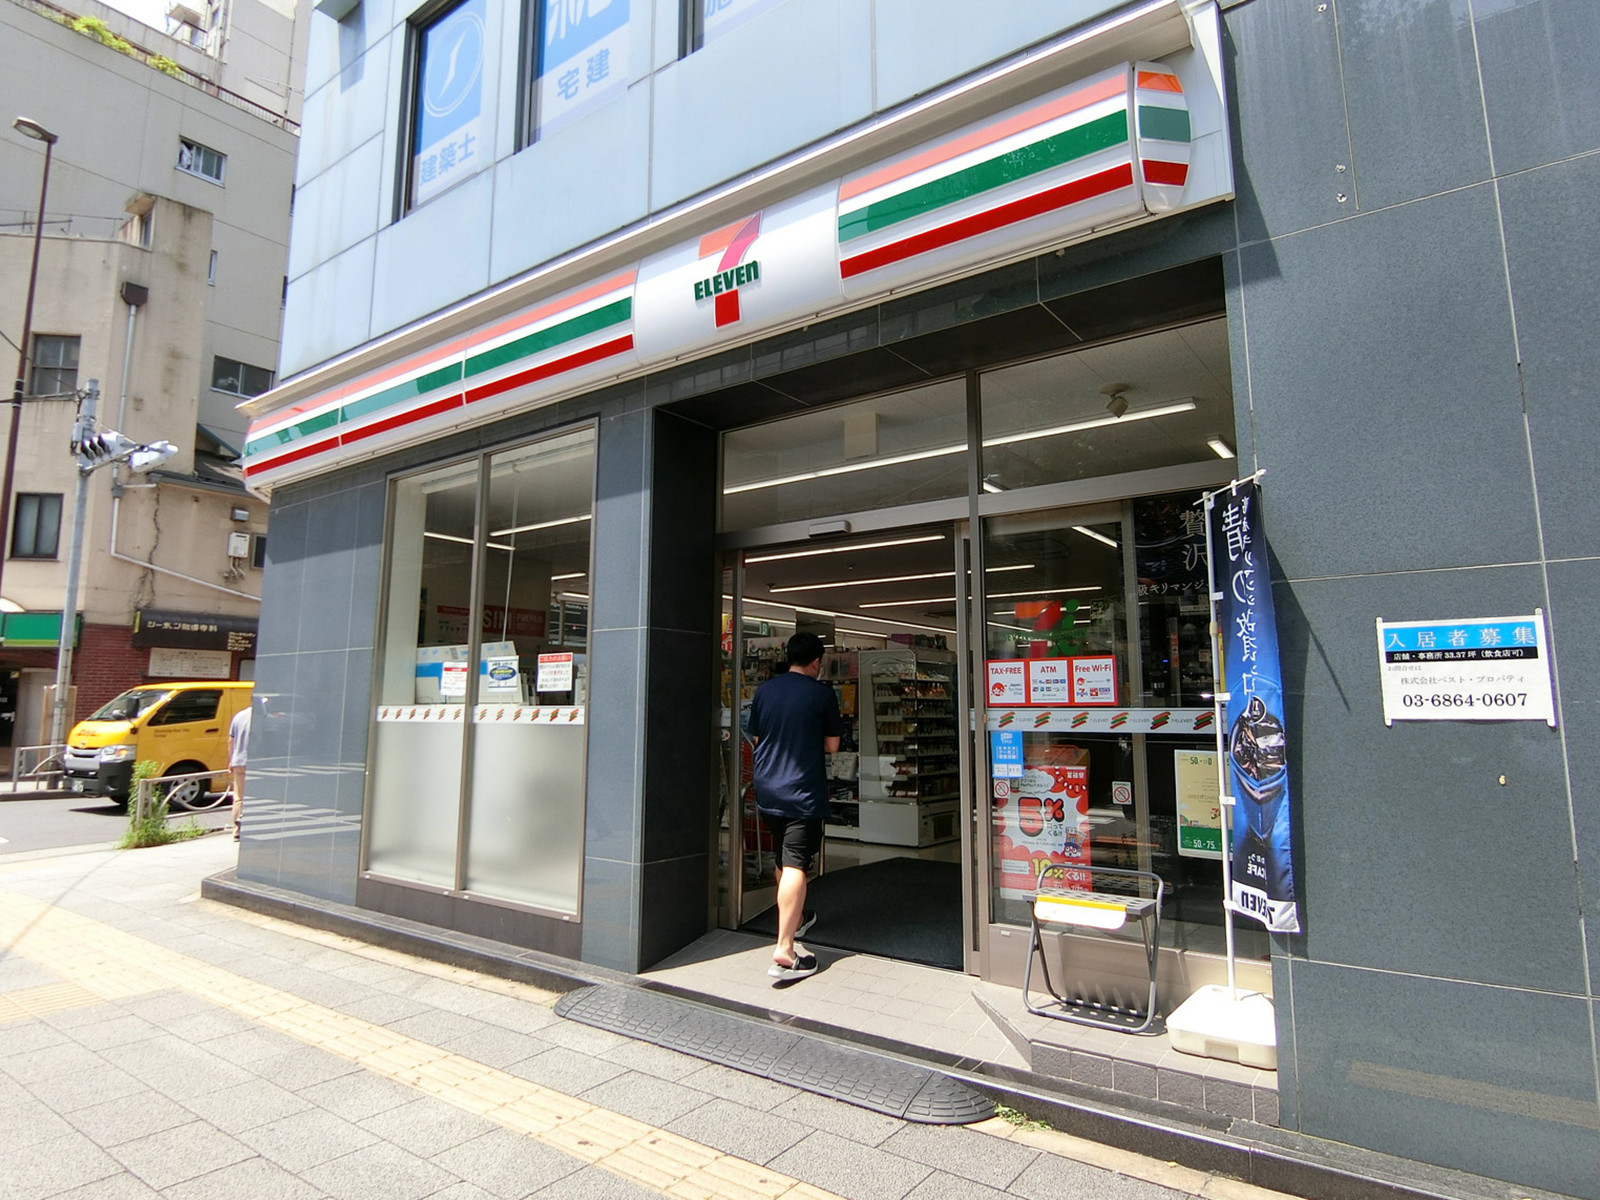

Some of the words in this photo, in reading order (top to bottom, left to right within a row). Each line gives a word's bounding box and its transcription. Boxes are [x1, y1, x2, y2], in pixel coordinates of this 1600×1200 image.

[557, 48, 611, 100] 宅建
[420, 133, 476, 185] 建築士
[1388, 627, 1535, 649] 入居者募集
[1092, 664, 1111, 672] Wi-Fi
[1403, 693, 1528, 707] 03-6864-0607
